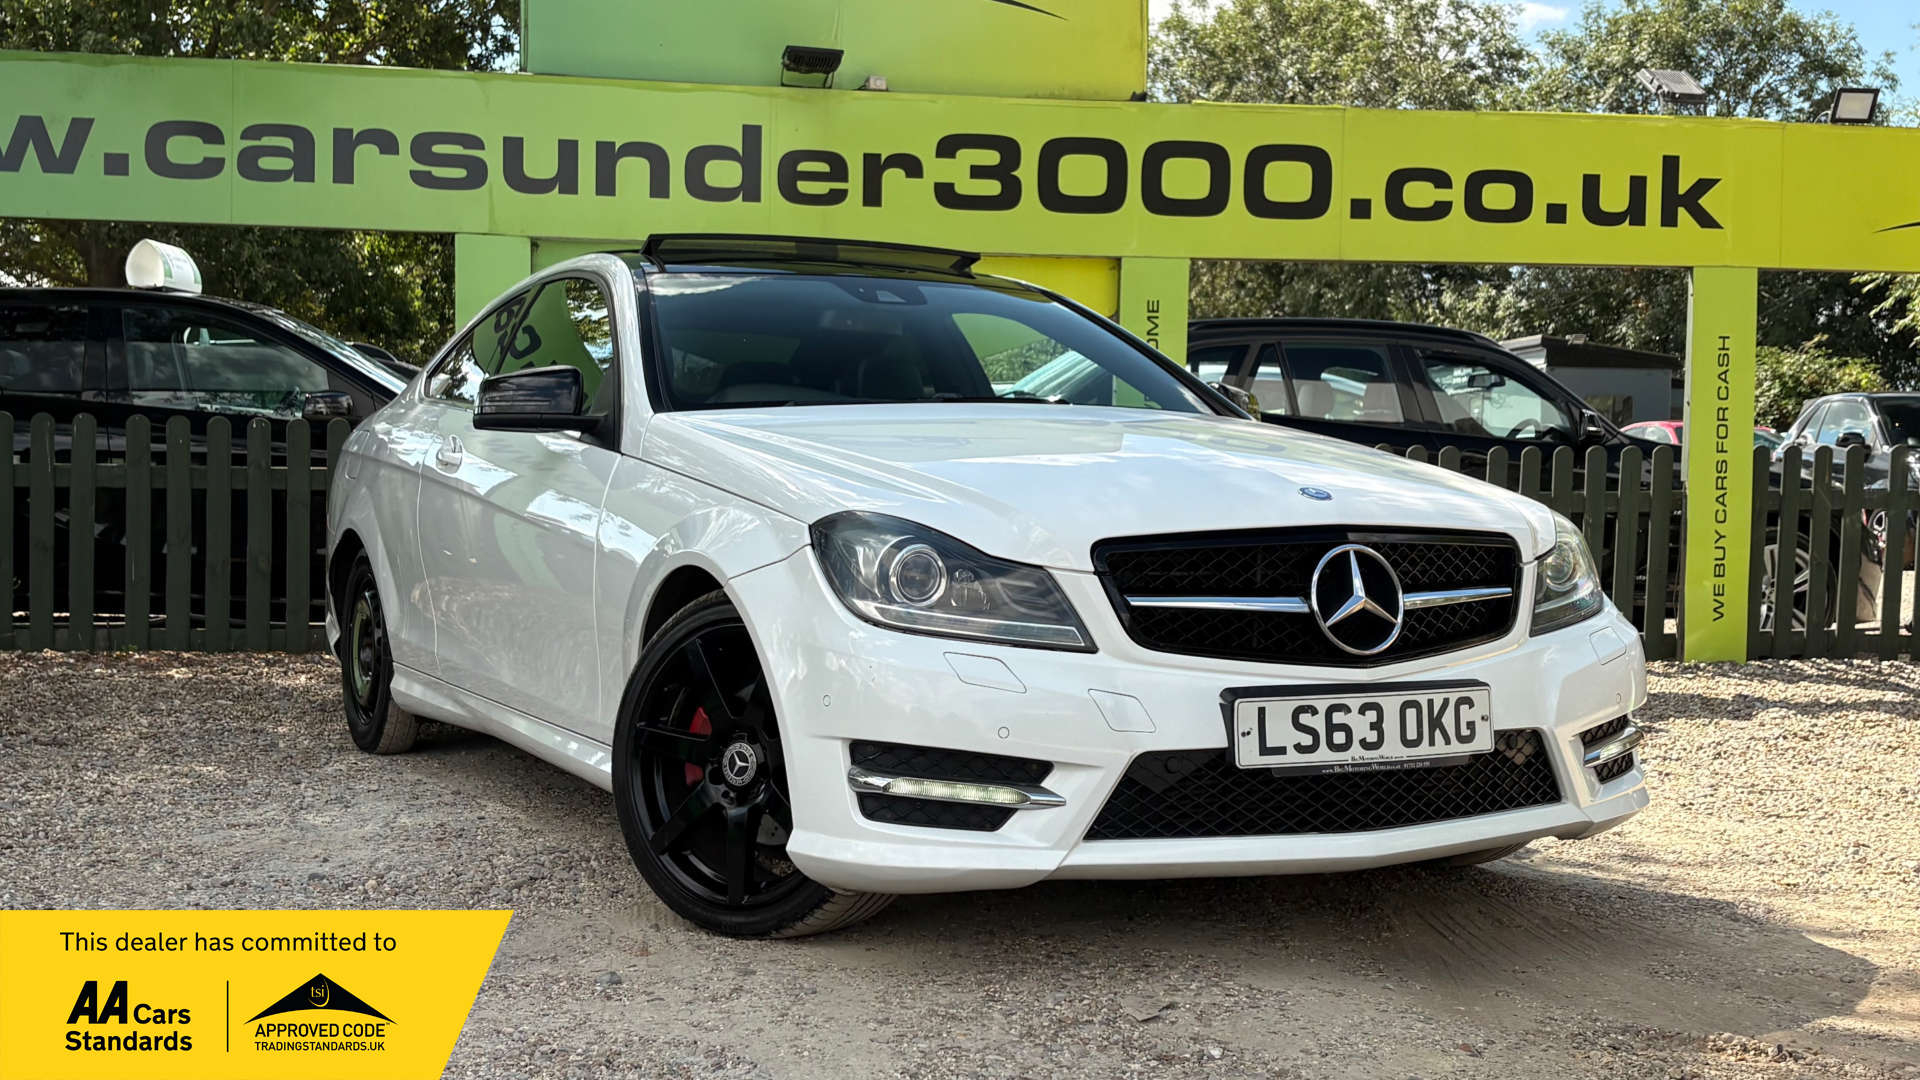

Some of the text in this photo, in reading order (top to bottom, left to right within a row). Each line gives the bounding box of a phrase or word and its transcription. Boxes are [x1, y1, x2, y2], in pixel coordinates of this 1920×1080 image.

[0, 115, 1724, 230] w.carsunder3000.co.uk
[1712, 335, 1731, 622] WE BUY CARS FOR CASH
[1257, 696, 1477, 757] LS63 OKG
